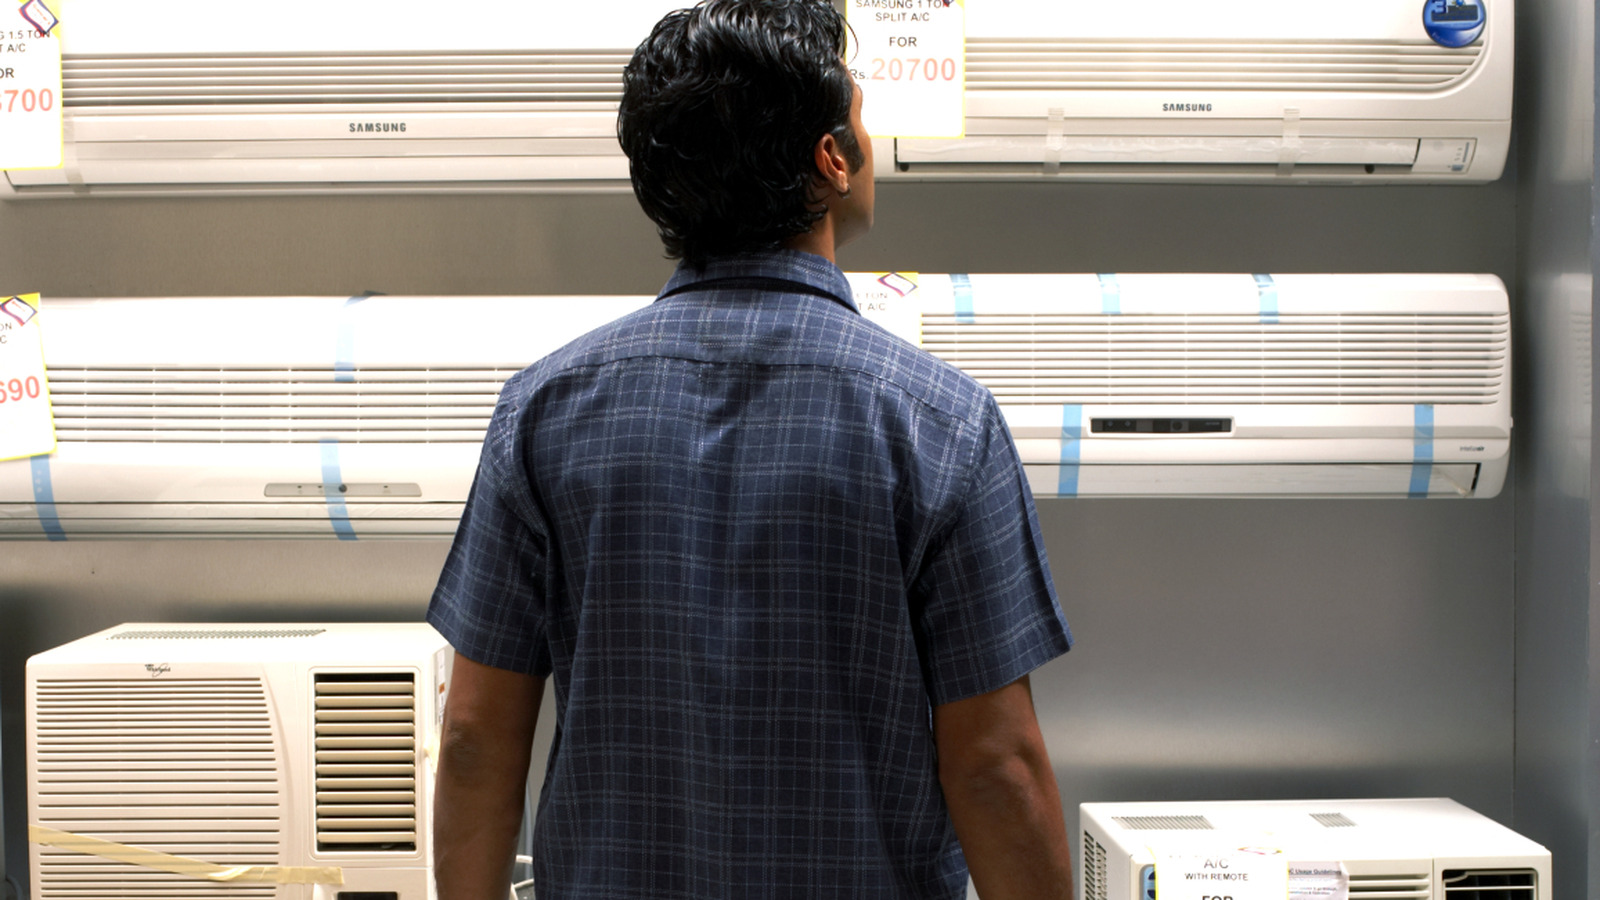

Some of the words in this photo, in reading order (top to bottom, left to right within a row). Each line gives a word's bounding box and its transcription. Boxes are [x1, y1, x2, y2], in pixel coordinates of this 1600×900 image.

[856, 0, 913, 9] SAMSUNG
[926, 0, 949, 9] TO
[875, 12, 907, 22] SPLIT
[910, 12, 930, 22] A/C
[9, 30, 23, 40] 1.5
[889, 36, 917, 47] FOR
[7, 43, 26, 53] A/C
[871, 58, 956, 81] 20700
[0, 88, 53, 113] 700
[1162, 103, 1213, 112] SAMSUNG
[349, 122, 407, 132] SAMSUNG
[1203, 858, 1229, 870] A/C
[1184, 872, 1209, 881] WITH
[1210, 872, 1249, 881] REMOTE
